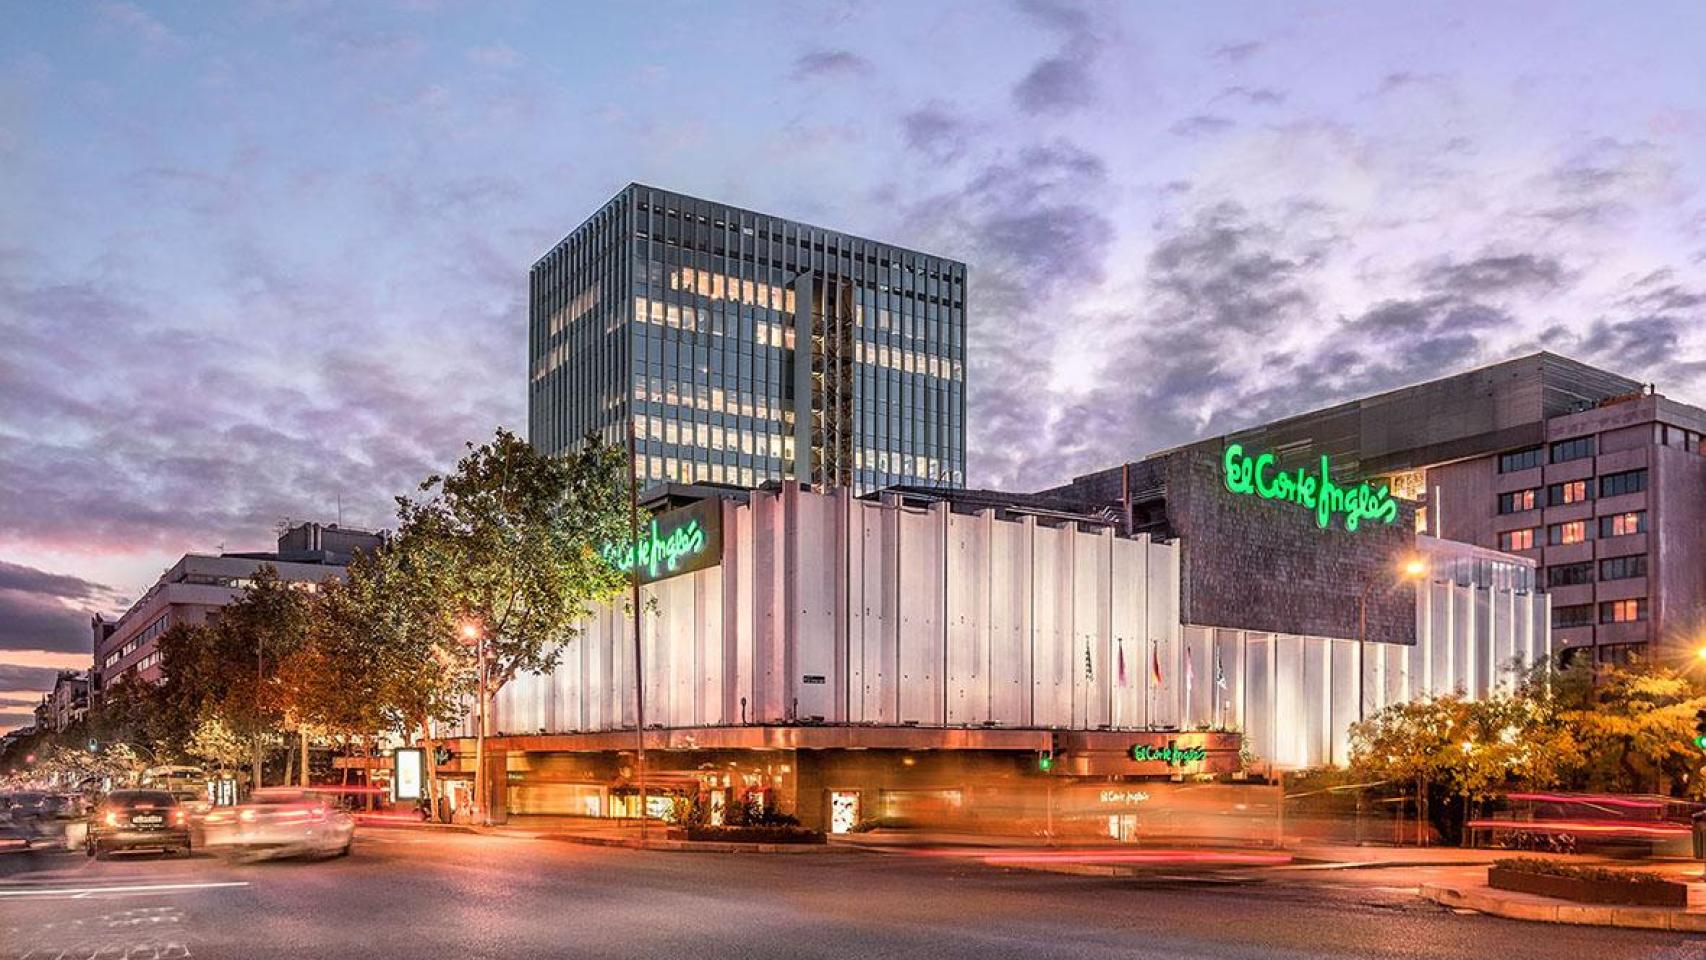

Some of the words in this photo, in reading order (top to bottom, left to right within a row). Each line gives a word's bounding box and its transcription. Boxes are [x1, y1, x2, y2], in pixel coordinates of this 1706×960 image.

[1225, 444, 1255, 494] El
[1254, 453, 1317, 509] Corte
[1317, 454, 1397, 532] Inglés
[1135, 744, 1147, 762] El
